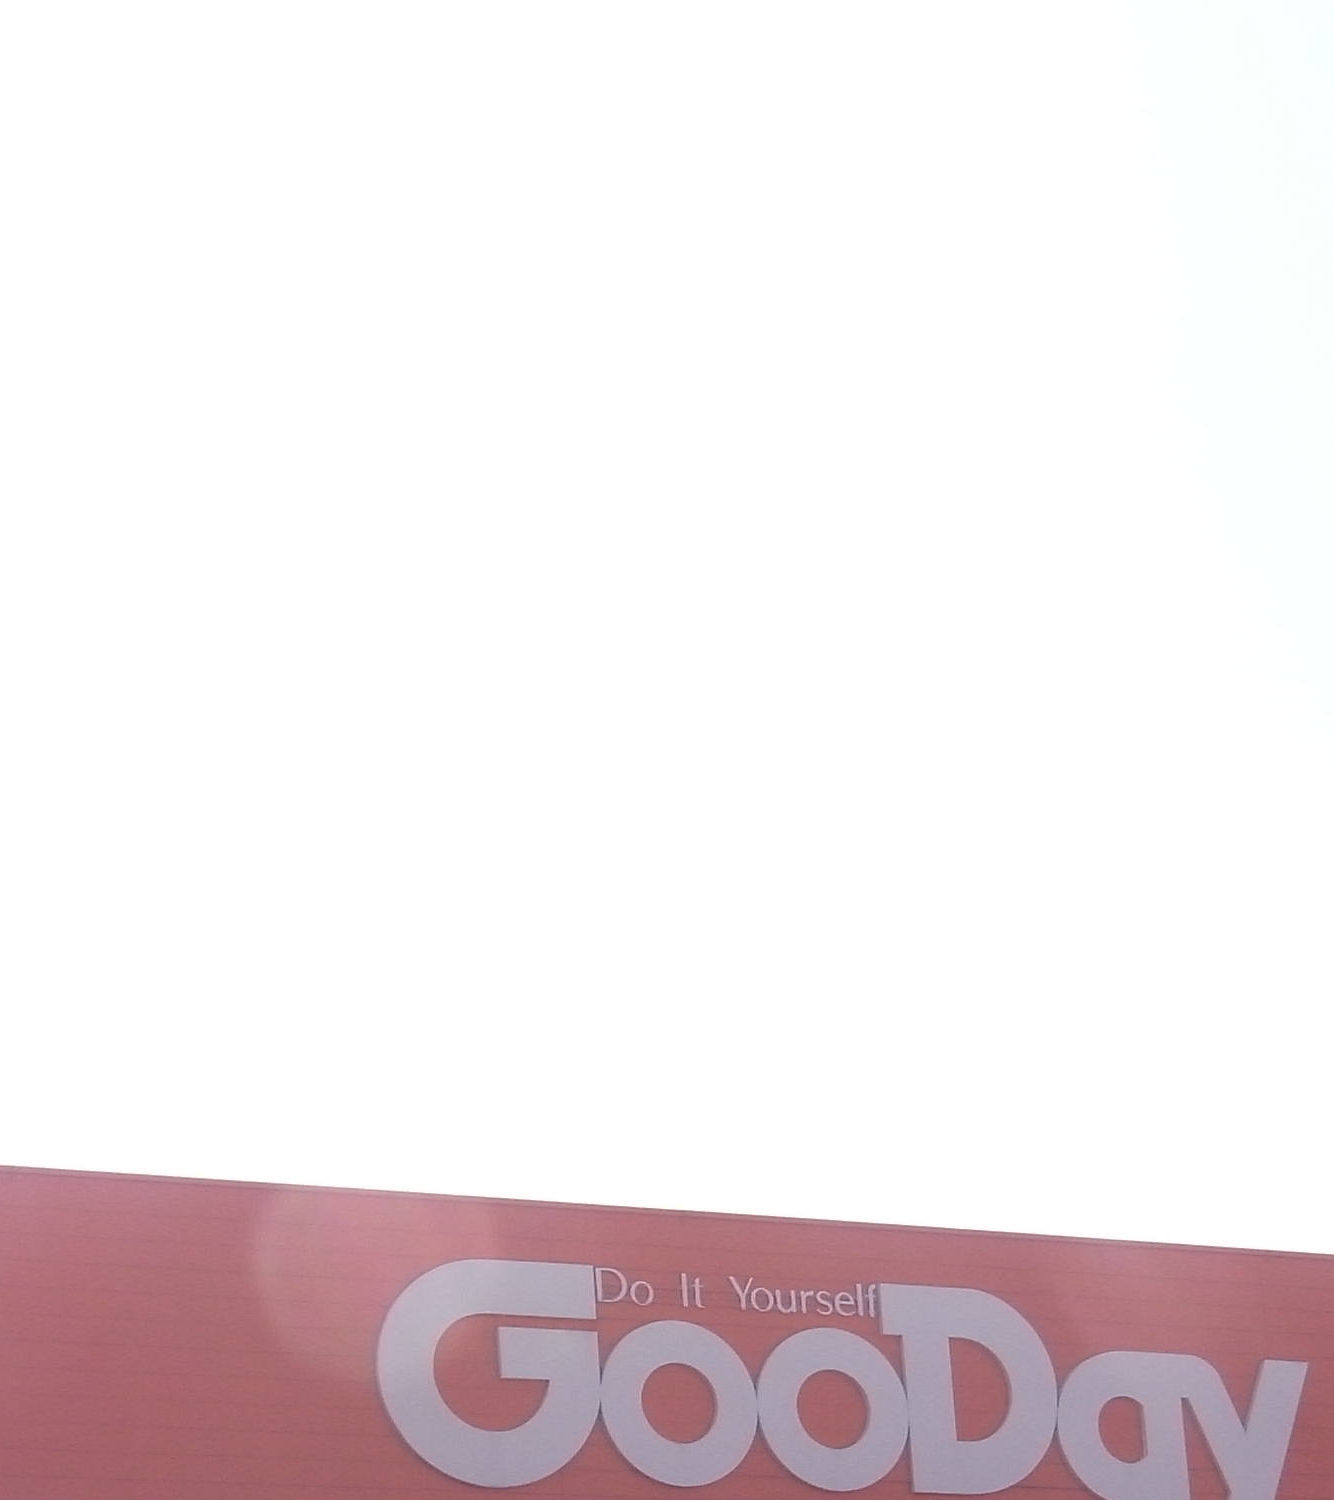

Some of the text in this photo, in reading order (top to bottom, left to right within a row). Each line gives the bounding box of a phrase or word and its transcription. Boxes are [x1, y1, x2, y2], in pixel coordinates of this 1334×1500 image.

[595, 1267, 877, 1318] Do It Yourself
